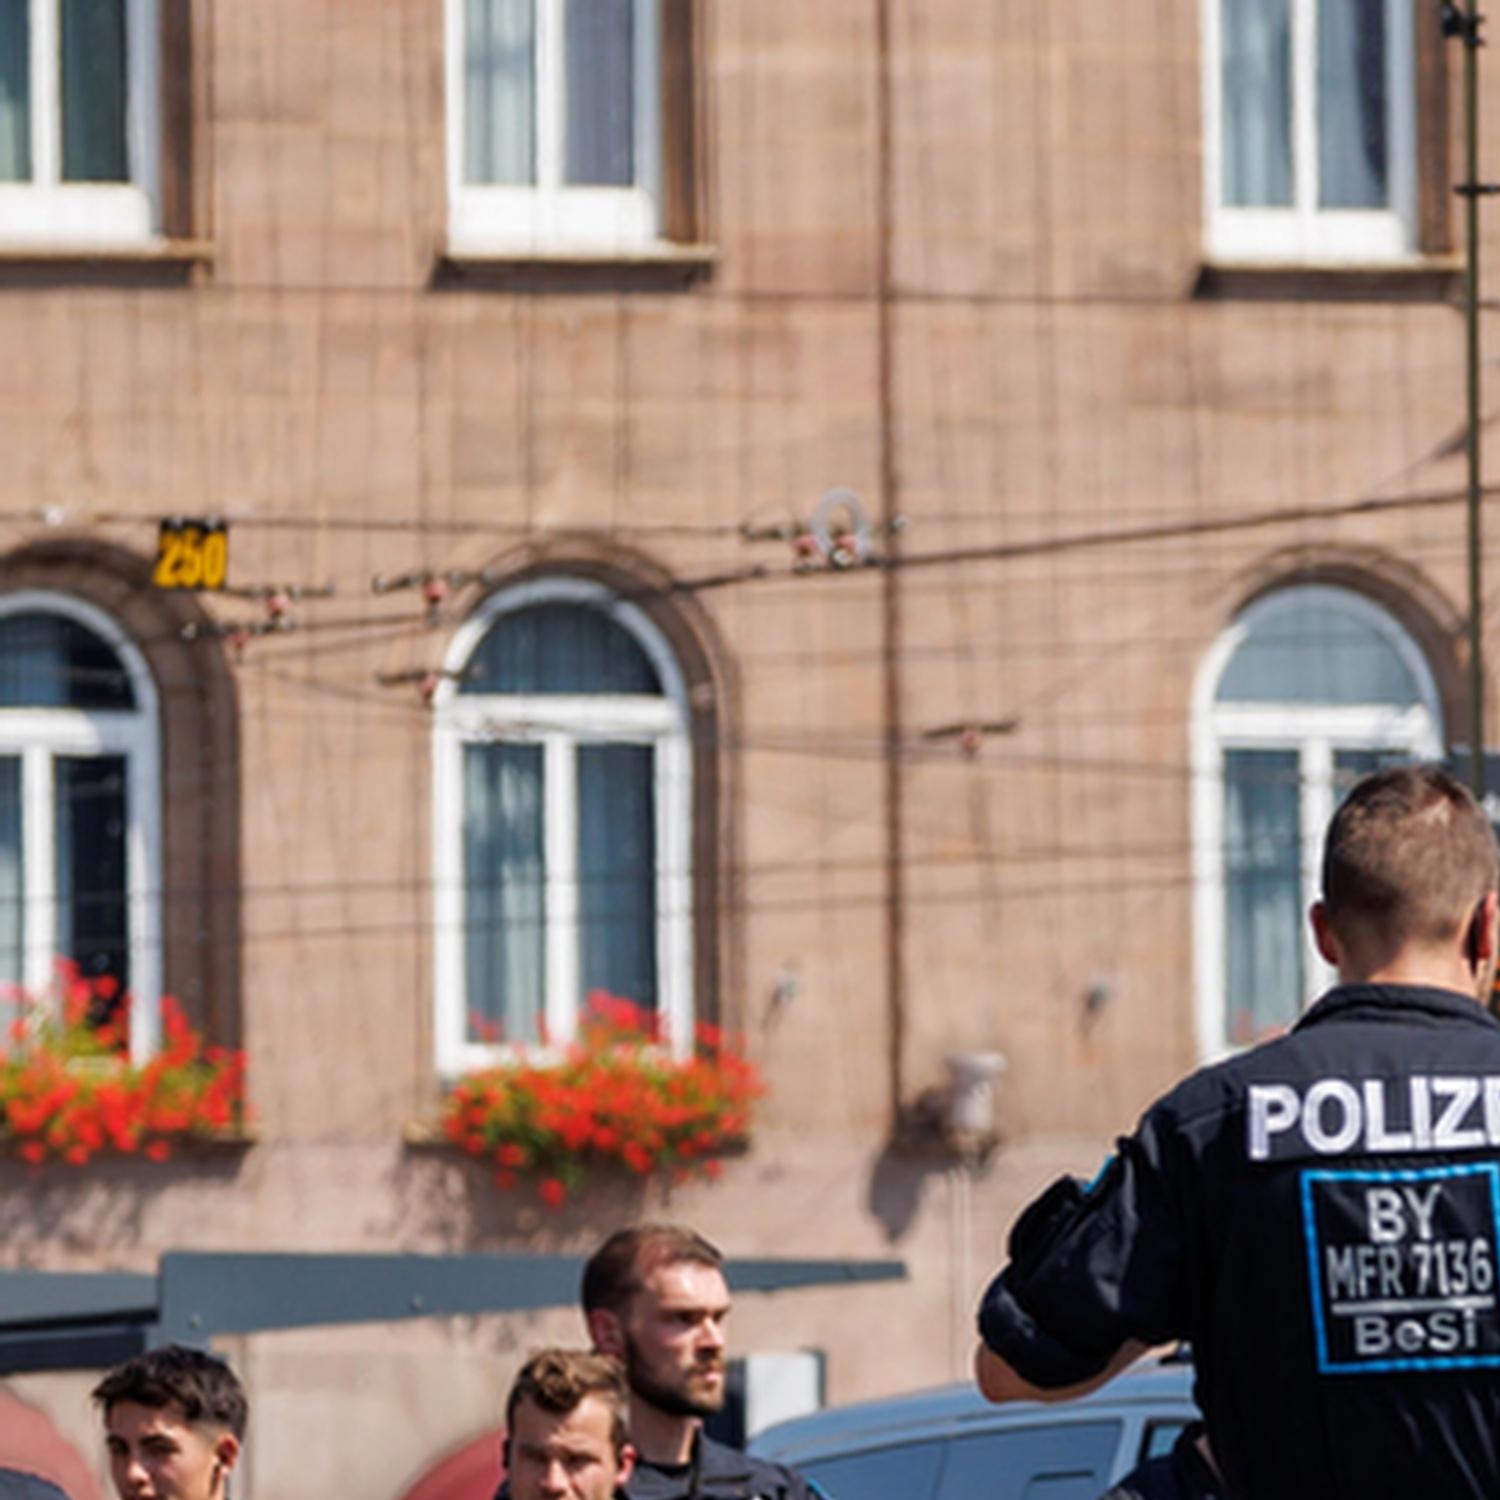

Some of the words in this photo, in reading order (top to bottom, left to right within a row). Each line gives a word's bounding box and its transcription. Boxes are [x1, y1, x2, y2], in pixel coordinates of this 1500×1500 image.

[154, 529, 228, 592] 250
[1365, 1184, 1441, 1244] BY
[1326, 1246, 1404, 1298] MFR
[1411, 1238, 1494, 1295] 7136
[1355, 1308, 1479, 1354] BeSi
